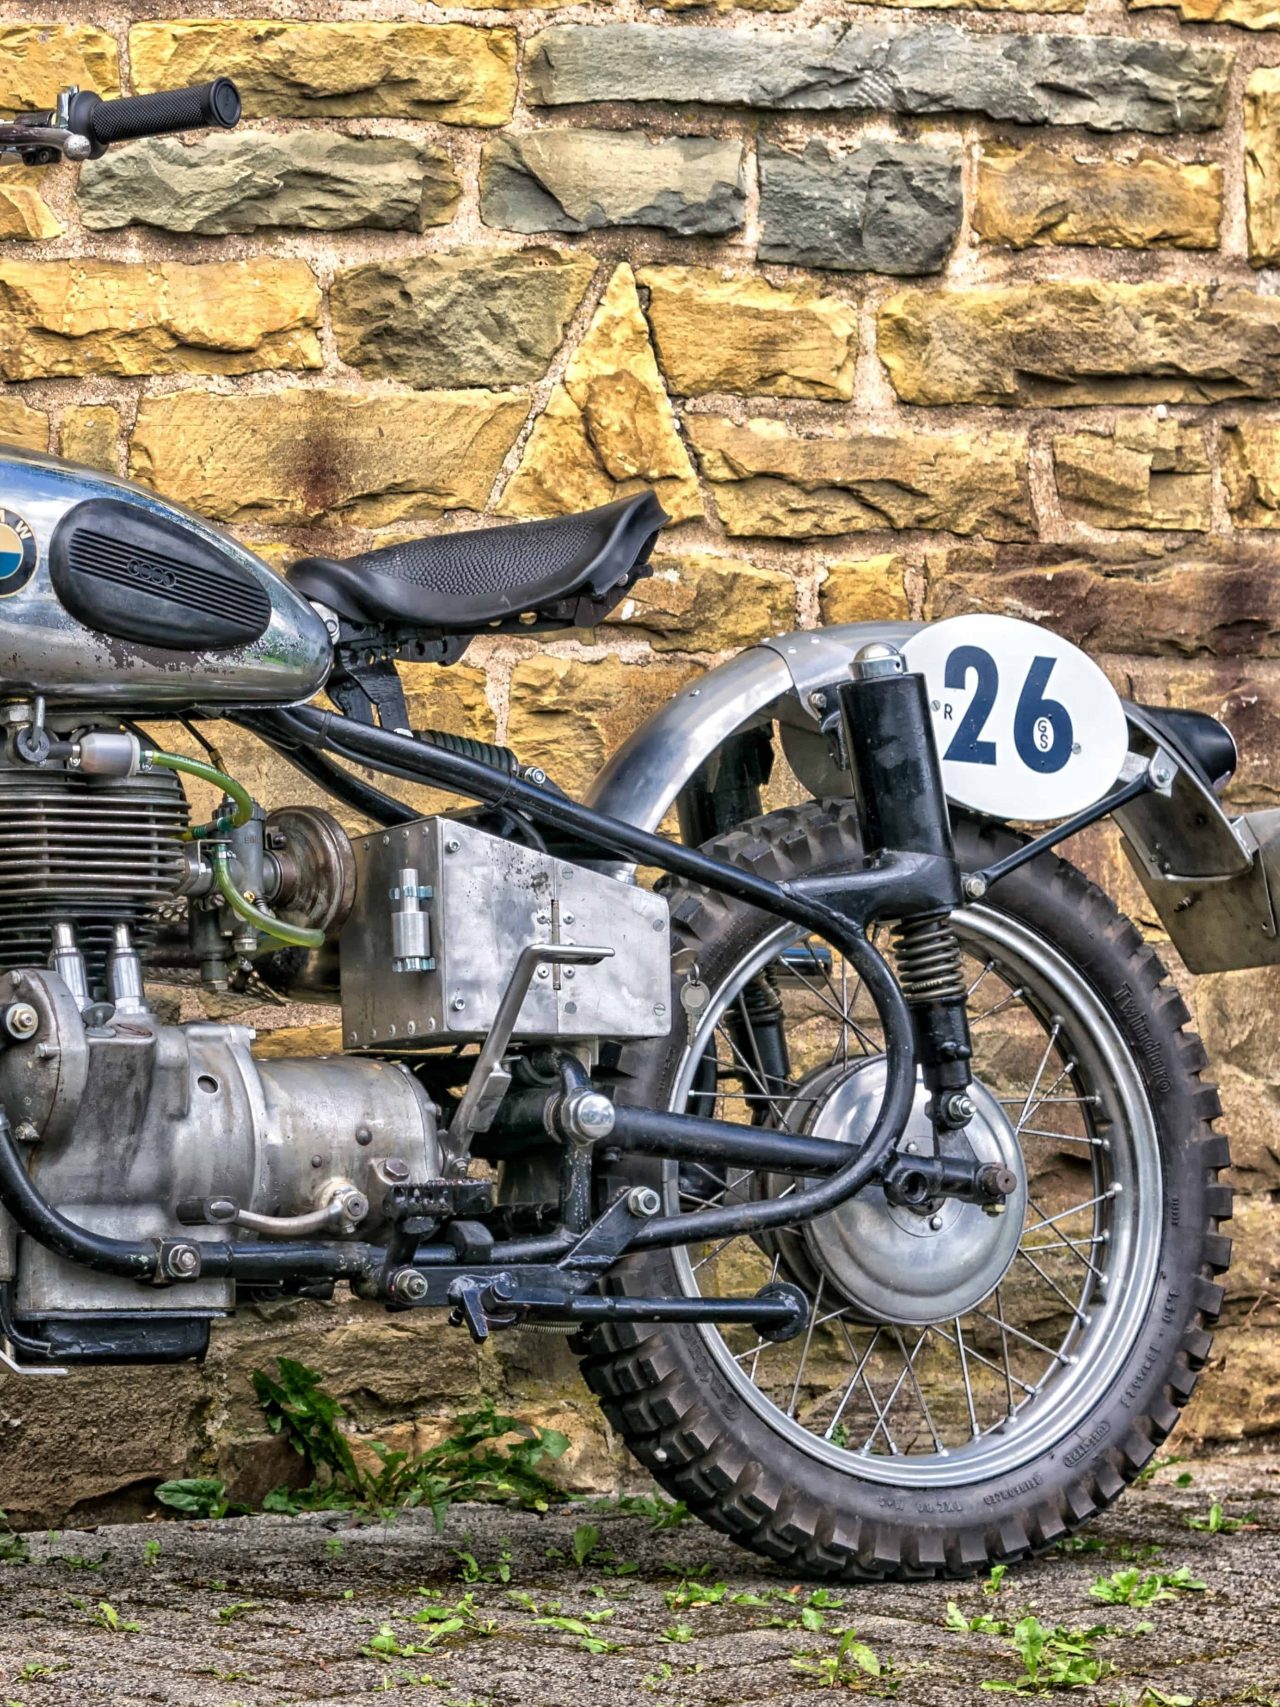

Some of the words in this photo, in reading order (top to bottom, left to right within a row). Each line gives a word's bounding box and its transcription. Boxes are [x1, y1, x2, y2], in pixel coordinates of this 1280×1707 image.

[942, 645, 1073, 774] 26
[944, 703, 953, 720] R
[1113, 981, 1173, 1094] Twinduro
